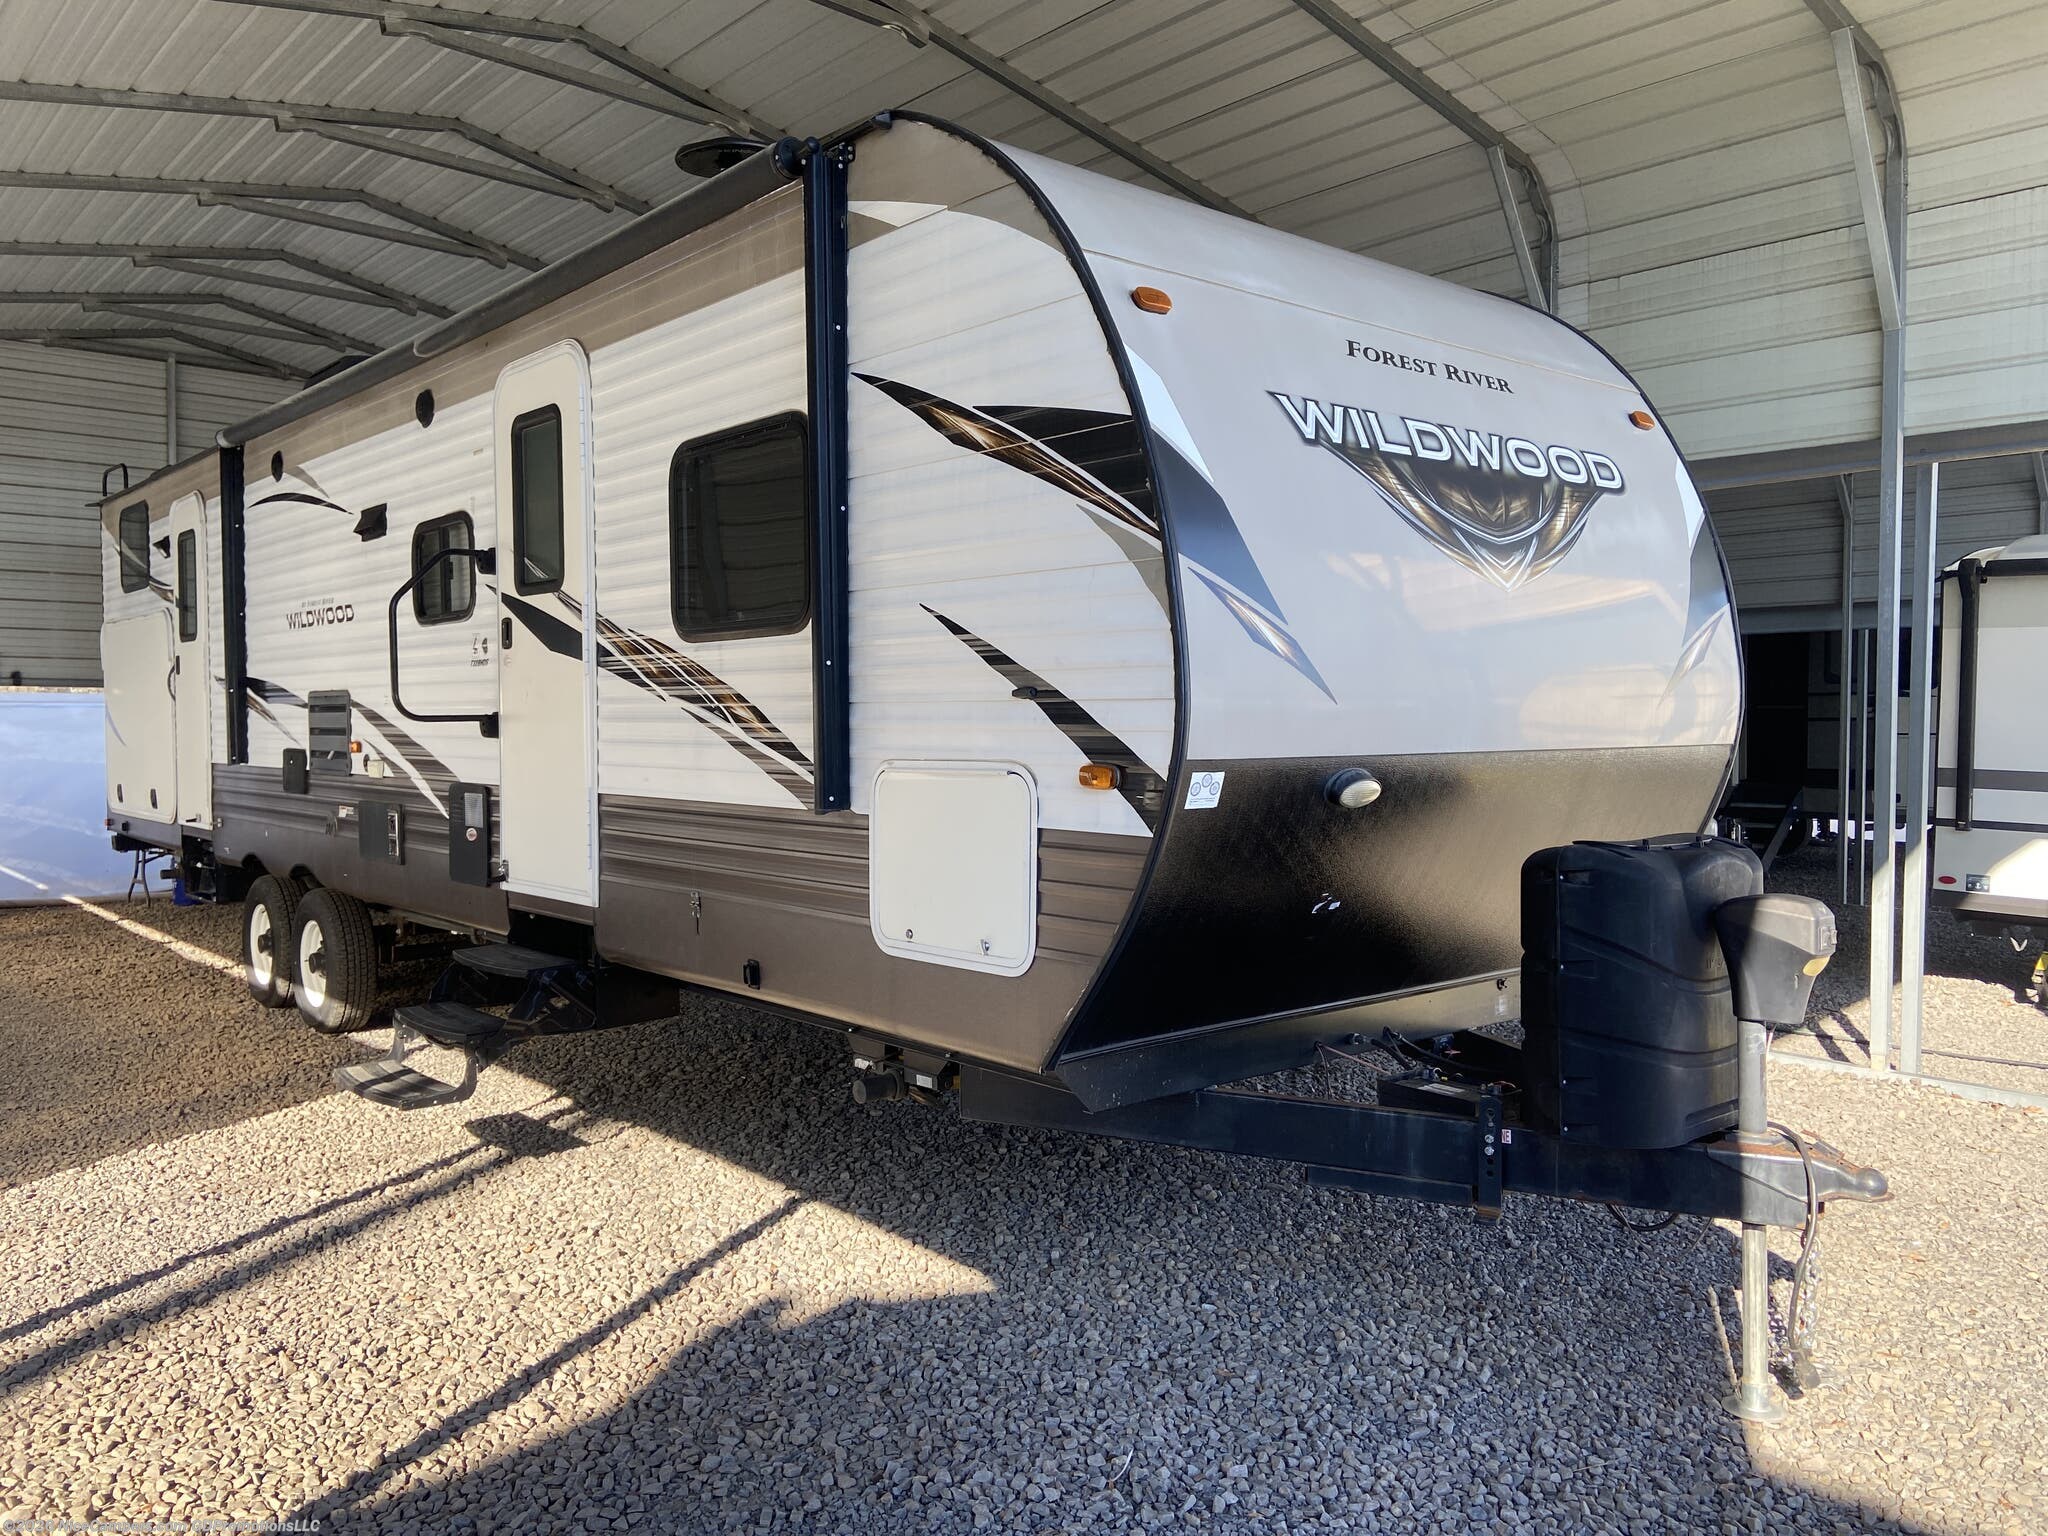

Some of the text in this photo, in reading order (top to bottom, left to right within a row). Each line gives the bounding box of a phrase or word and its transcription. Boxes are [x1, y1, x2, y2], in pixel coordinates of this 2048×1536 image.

[1346, 340, 1514, 394] FOREST RIVER
[1268, 391, 1624, 491] WILDWOOD
[286, 604, 354, 629] WILDWOOD
